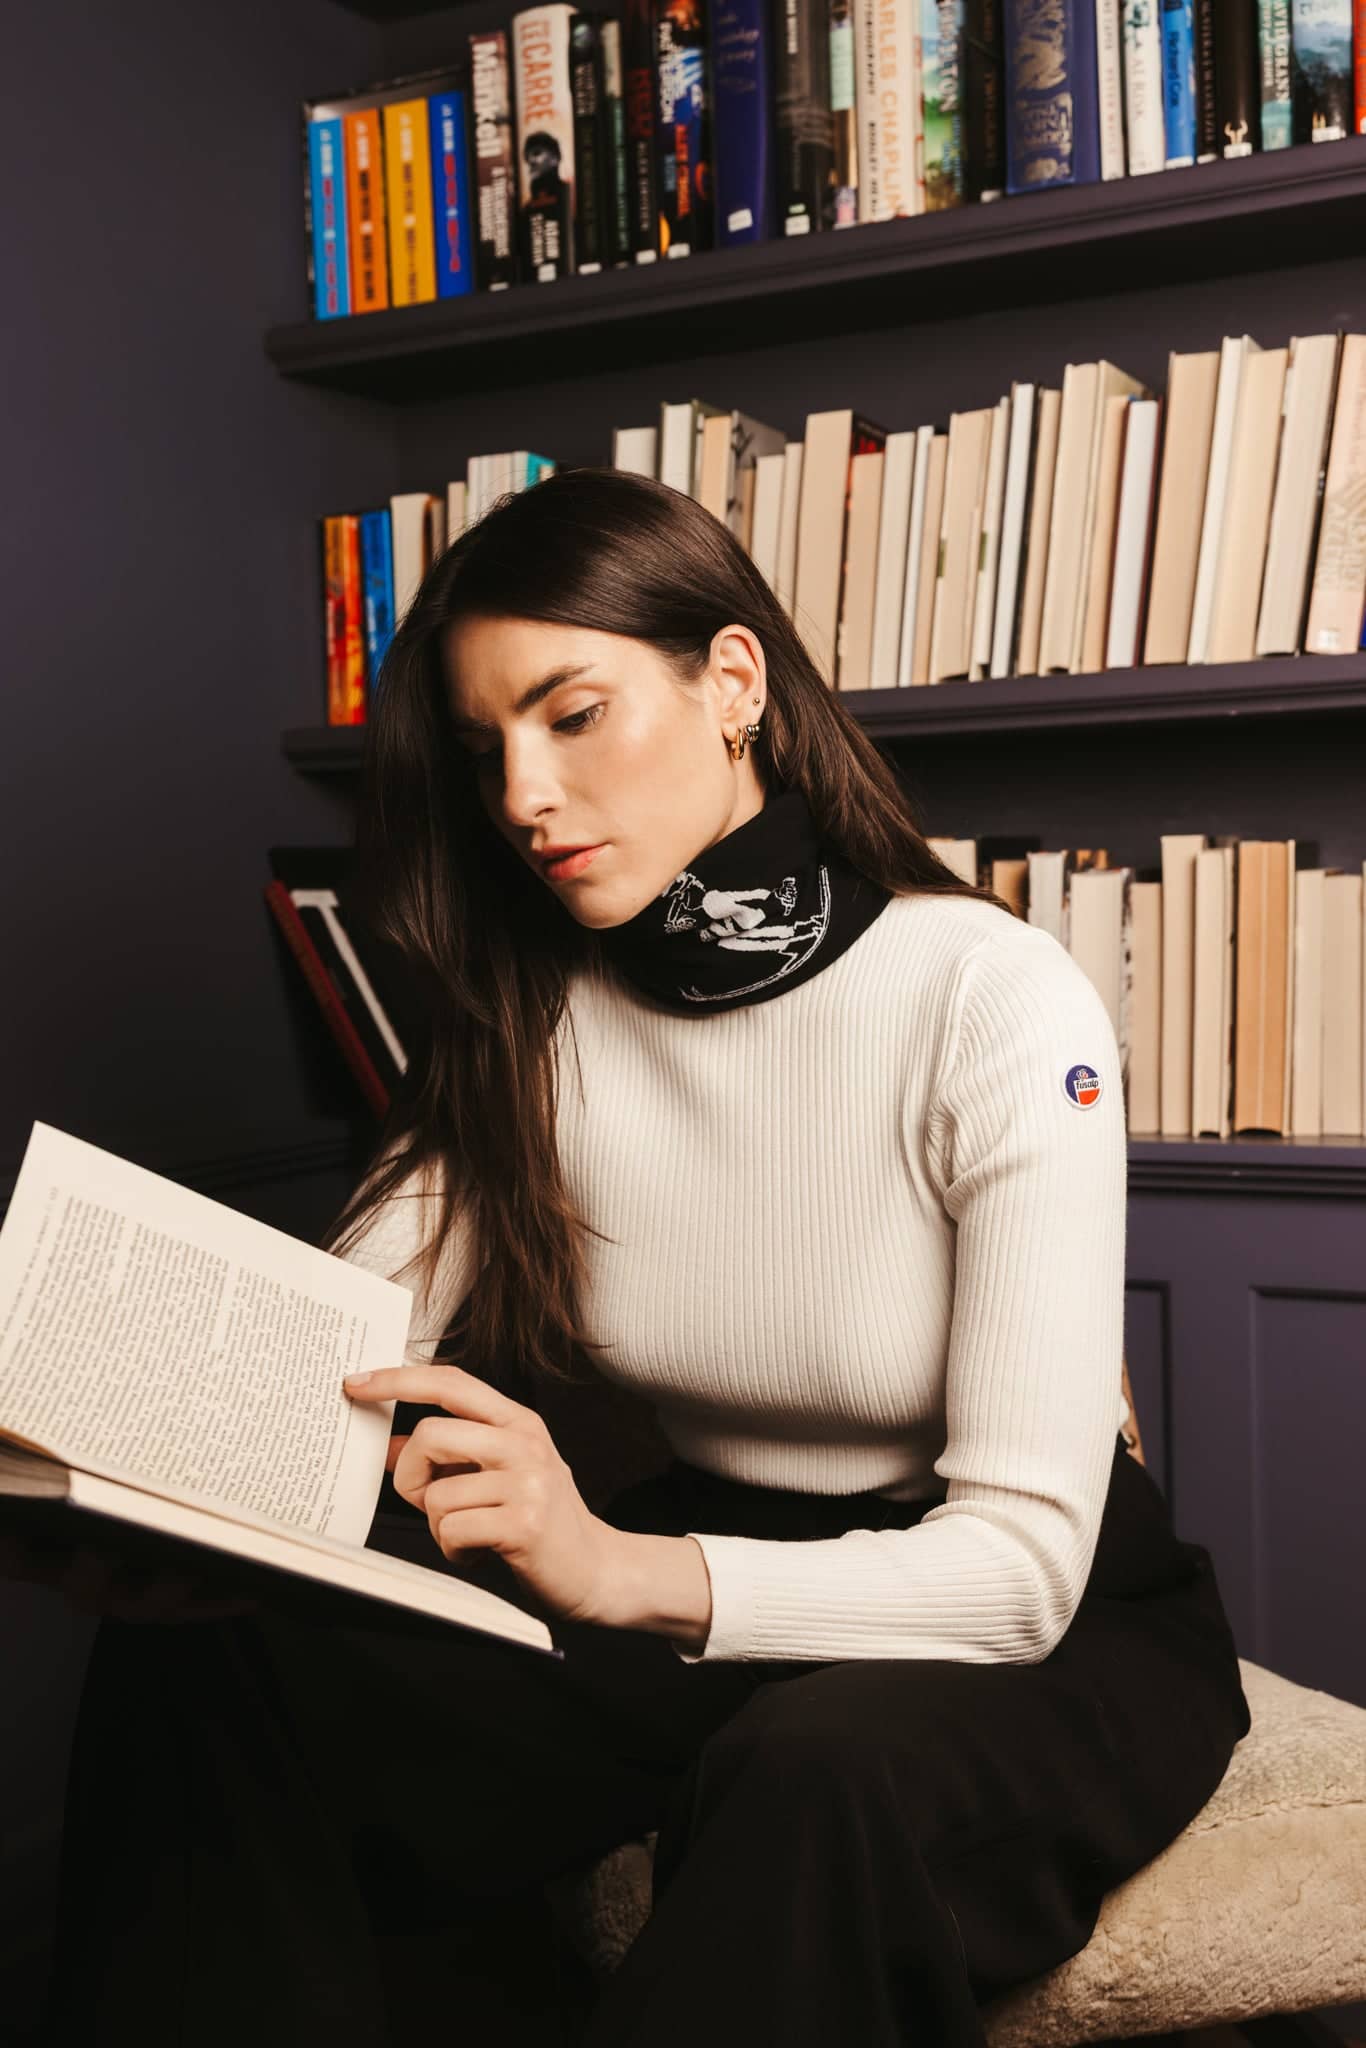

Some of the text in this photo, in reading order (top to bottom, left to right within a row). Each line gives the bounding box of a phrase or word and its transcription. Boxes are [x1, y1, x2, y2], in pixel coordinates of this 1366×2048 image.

[471, 41, 503, 157] Mankell
[878, 90, 902, 210] CHAPLIN
[1076, 1079, 1099, 1090] fusalp
